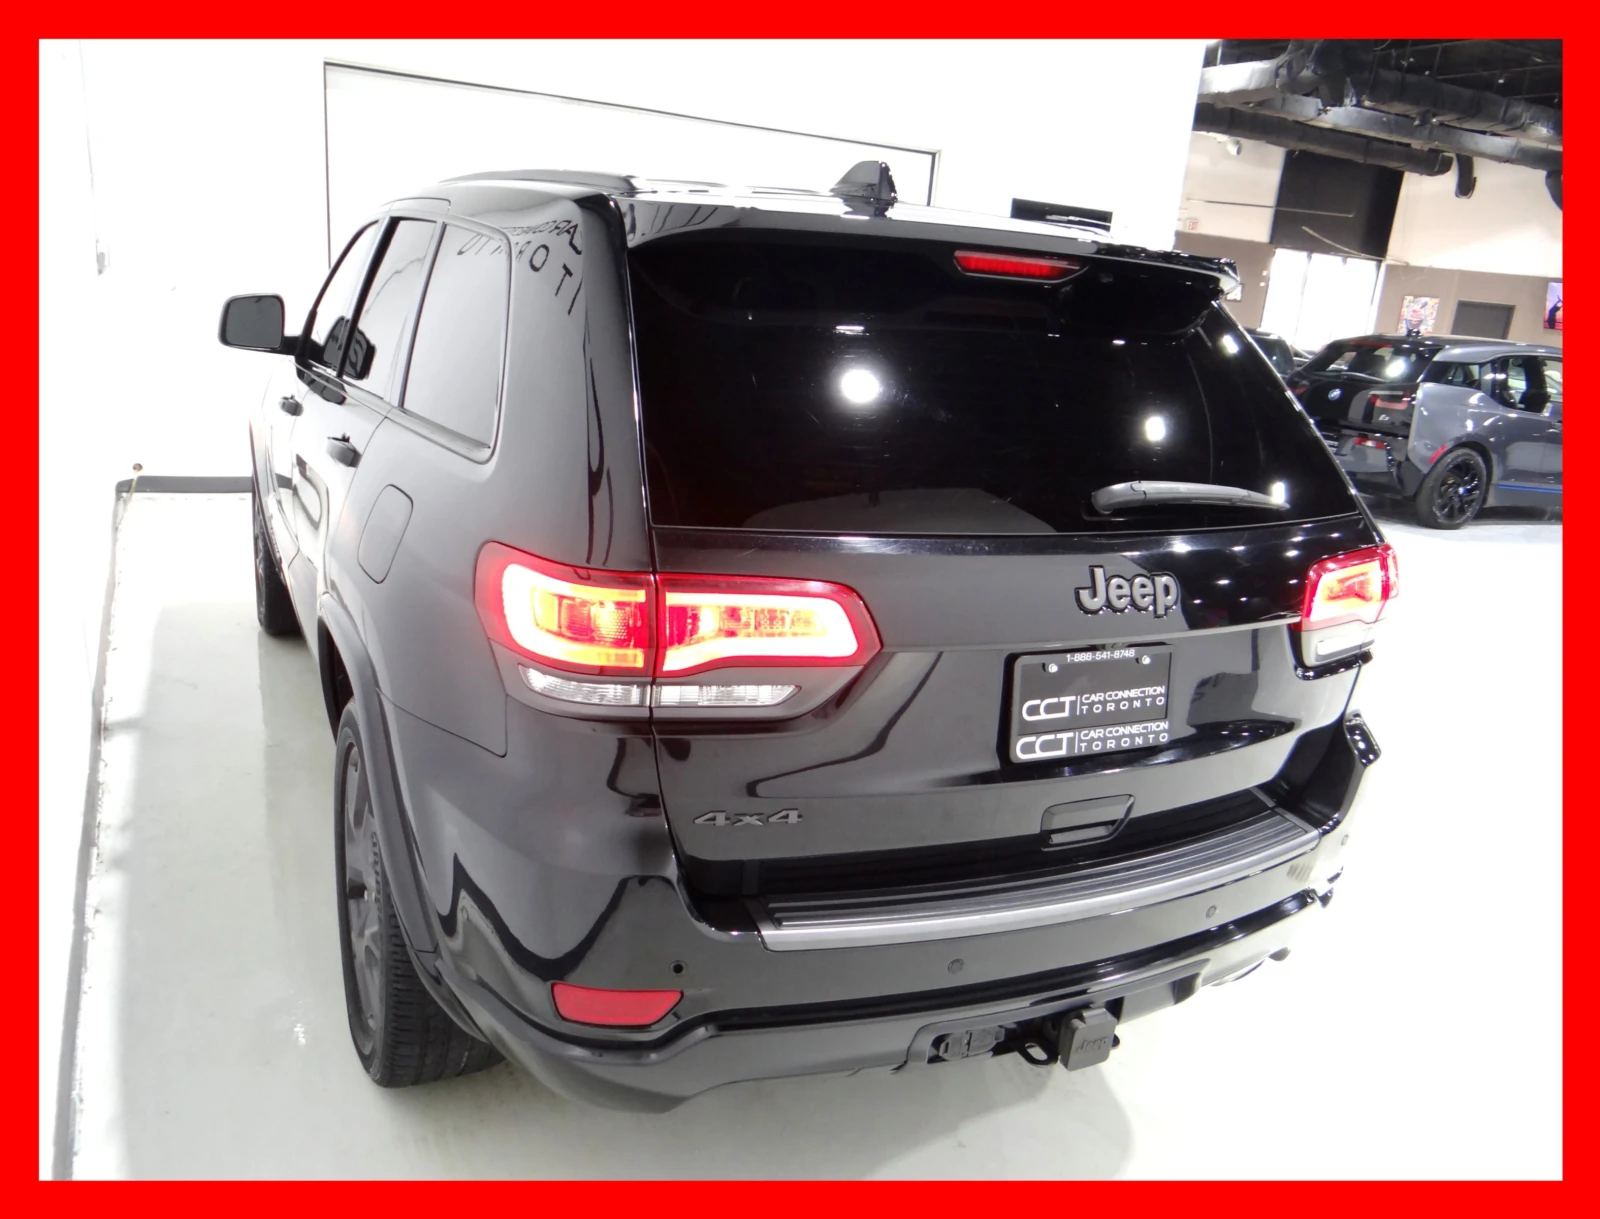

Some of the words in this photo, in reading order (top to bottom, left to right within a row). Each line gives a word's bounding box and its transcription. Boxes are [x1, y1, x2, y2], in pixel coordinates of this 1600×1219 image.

[1074, 564, 1181, 619] Jeep
[1066, 649, 1136, 663] 1-888-541-8748
[1021, 695, 1076, 722] CCT
[1081, 692, 1104, 704] CAR
[1105, 685, 1166, 701] CONNECTION
[1081, 696, 1165, 715] TORONTO
[1015, 731, 1074, 760] CCT
[1080, 727, 1104, 741] CAR
[1105, 720, 1169, 738] CONNECTION
[1079, 732, 1169, 753] TORONTO
[692, 807, 804, 827] 4x4
[1075, 1035, 1109, 1053] Jeep
